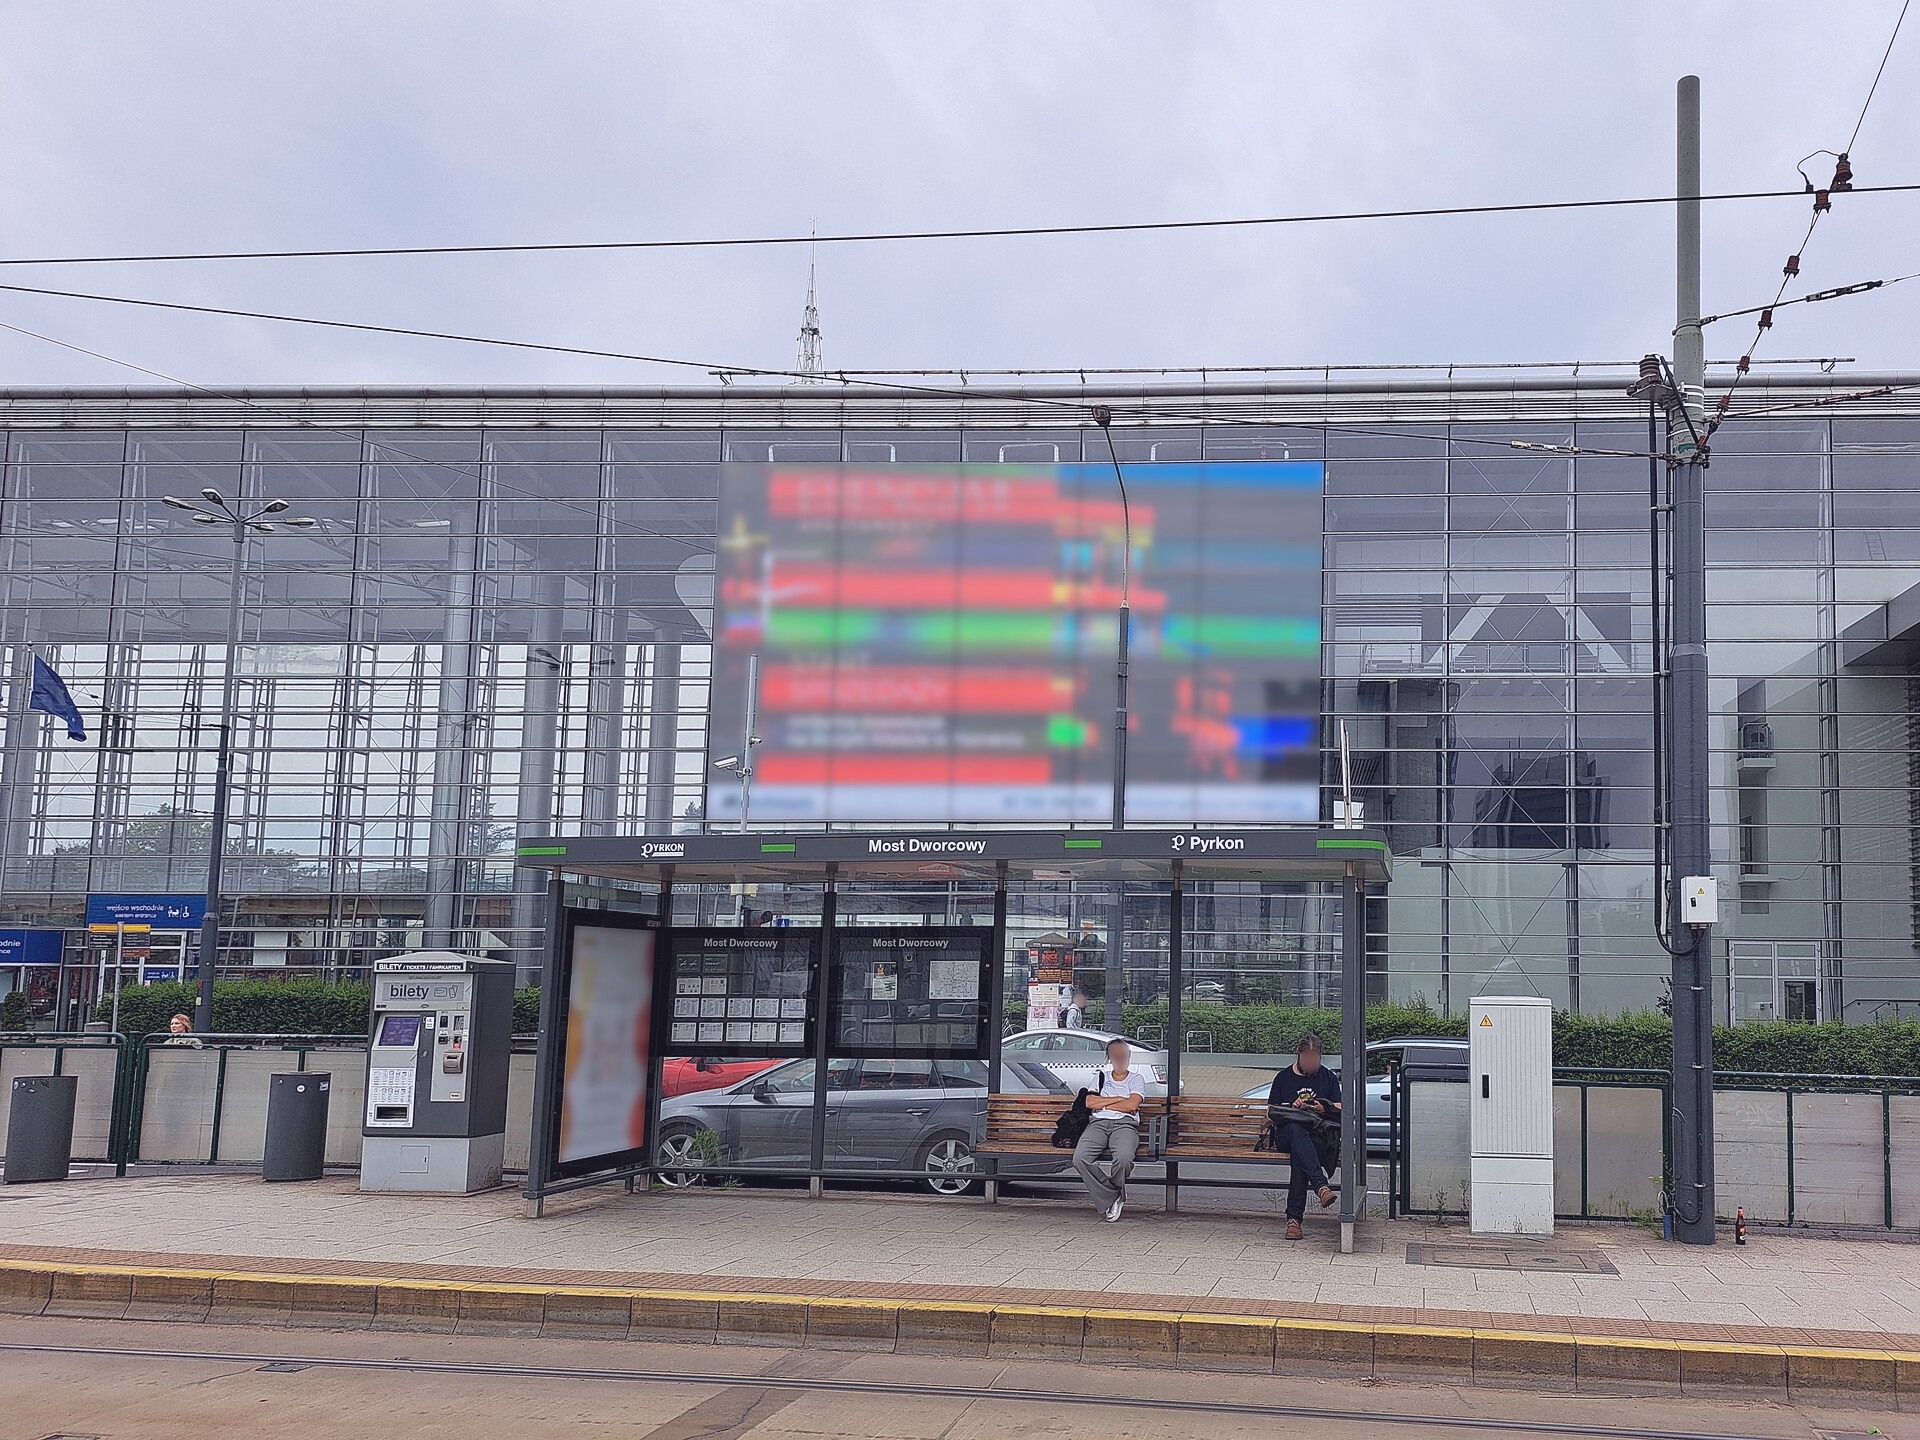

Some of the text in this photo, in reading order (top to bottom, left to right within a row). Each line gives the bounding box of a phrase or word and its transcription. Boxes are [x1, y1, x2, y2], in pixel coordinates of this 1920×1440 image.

[868, 838, 986, 854] Most Dworcowy
[1190, 836, 1244, 852] Pyrkon
[703, 938, 778, 949] Most Dworcowy
[872, 938, 949, 949] Most Dworcowy
[390, 984, 430, 1000] bilety
